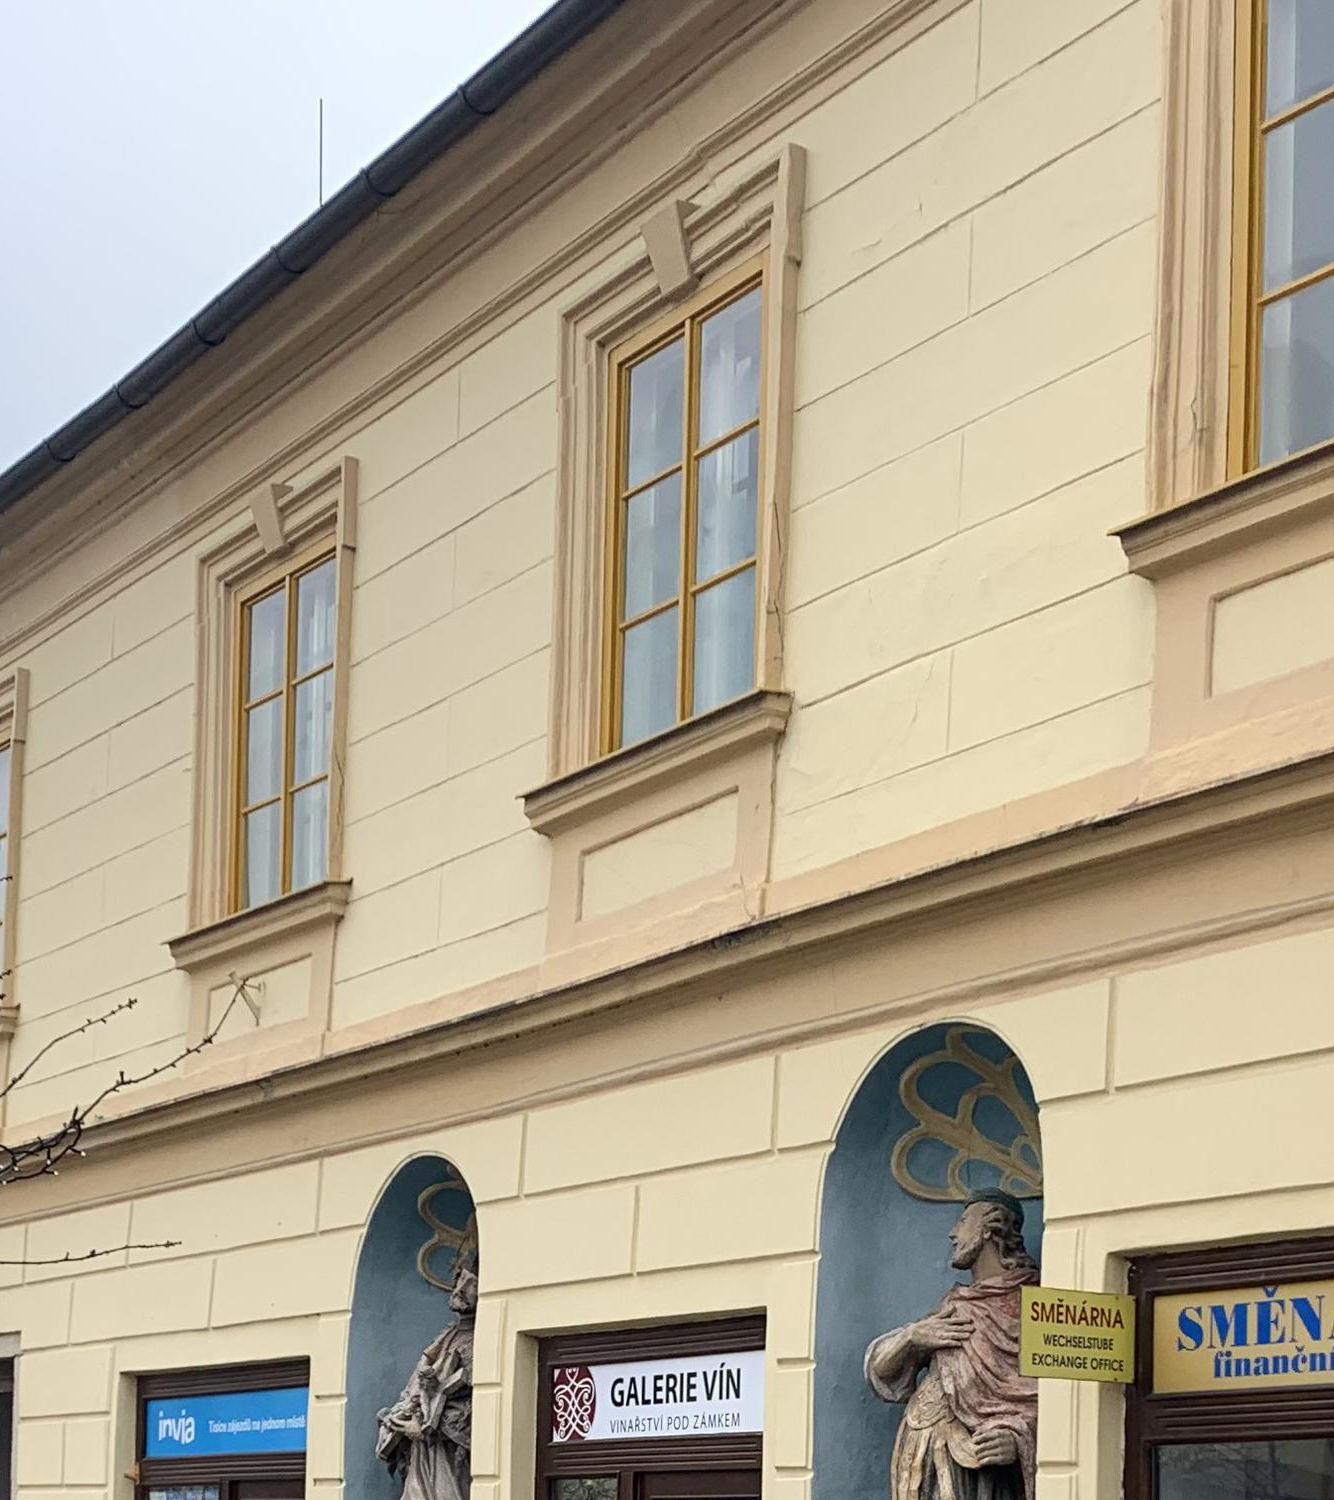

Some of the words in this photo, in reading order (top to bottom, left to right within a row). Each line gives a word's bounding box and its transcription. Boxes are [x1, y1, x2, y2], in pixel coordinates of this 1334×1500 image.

[1030, 1298, 1125, 1329] SMĚNÁRNA
[1043, 1333, 1114, 1351] WECHSELSTUBE
[1032, 1353, 1088, 1369] EXCHANGE
[1090, 1358, 1124, 1372] OFFICE
[610, 1372, 698, 1408] GALERIE
[702, 1362, 741, 1401] VÍN
[158, 1409, 195, 1444] invia
[610, 1414, 664, 1433] VINAŘSTVÍ
[667, 1415, 689, 1430] POD
[693, 1412, 740, 1430] ZÁMKEM
